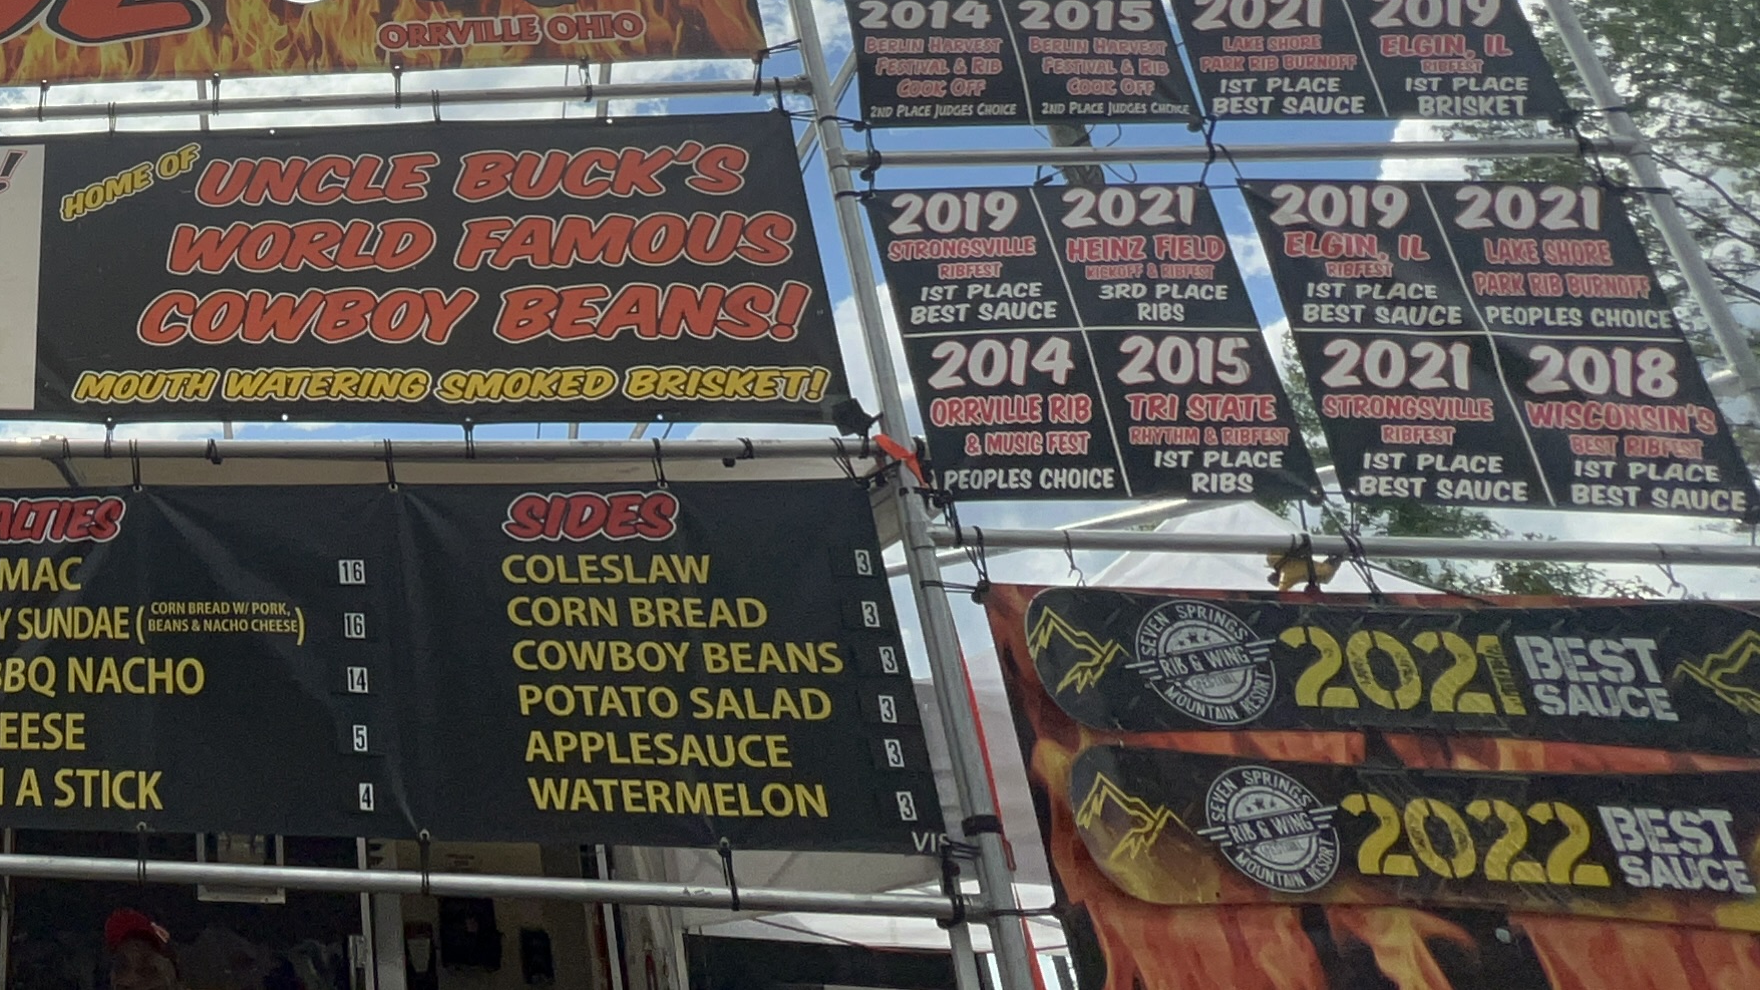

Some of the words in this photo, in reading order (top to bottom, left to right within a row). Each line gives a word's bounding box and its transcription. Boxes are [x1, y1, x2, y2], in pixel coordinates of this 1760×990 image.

[379, 16, 541, 51] ORRVILLE
[545, 11, 646, 43] OHIO
[1484, 34, 1513, 57] IL
[1418, 95, 1528, 117] BRISKET
[60, 161, 153, 222] HOME
[155, 142, 201, 180] OF
[194, 151, 440, 207] UNCLE
[453, 139, 750, 201] BUCK'S
[888, 190, 1018, 235] 2019
[1454, 185, 1602, 231] 2021
[166, 219, 437, 275] WORLD
[453, 209, 796, 271] FAMOUS
[888, 235, 1036, 261] STRONGSVILLE
[938, 262, 1003, 280] RIBFEST
[136, 285, 476, 345] COWBOY
[492, 280, 811, 342] BEANS!
[910, 304, 970, 325] BEST
[978, 301, 1058, 321] SAUCE
[928, 335, 1076, 390] 2014
[1525, 344, 1679, 398] 2018
[72, 368, 218, 403] MOUTH
[221, 368, 429, 403] WATERING
[437, 366, 620, 402] SMOKED
[622, 366, 828, 402] BRISKET!
[930, 394, 1041, 427] ORRVILLE
[1048, 394, 1092, 423] RIB
[1525, 400, 1718, 435] WISCONSIN'S
[965, 435, 980, 455] &
[986, 433, 1043, 455] MUSIC
[1048, 431, 1090, 454] FEST
[944, 468, 1032, 490] PEOPLES
[1040, 467, 1115, 489] CHOICE
[502, 492, 679, 542] SIDES
[338, 560, 366, 584] 16
[502, 554, 710, 585] COLESLAW
[148, 618, 188, 633] BEANS
[190, 619, 202, 632] &
[203, 619, 248, 633] NACHO
[251, 619, 298, 634] CHEESE
[150, 602, 187, 615] CORN
[188, 602, 231, 615] BREAD
[233, 602, 250, 615] W/
[251, 602, 291, 618] PORK,
[507, 597, 618, 628] CORN
[628, 597, 768, 628] BREAD
[1140, 610, 1170, 657] SEVEN
[1175, 604, 1248, 642] SPRINGS
[68, 658, 206, 695] NACHO
[1159, 656, 1187, 678] RIB
[1189, 652, 1202, 670] &
[1204, 645, 1251, 667] WING
[1278, 625, 1528, 716] 2021
[1513, 634, 1659, 686] BEST
[518, 684, 679, 717] POTATO
[690, 687, 833, 721] SALAD
[1164, 685, 1240, 722] MOUNTAIN
[1240, 671, 1272, 712] RESORT
[1534, 684, 1680, 722] SAUCE
[527, 778, 830, 818] WATERMELON
[1340, 791, 1611, 888] 2022
[1594, 804, 1735, 856] BEST
[1619, 854, 1758, 896] SAUCE
